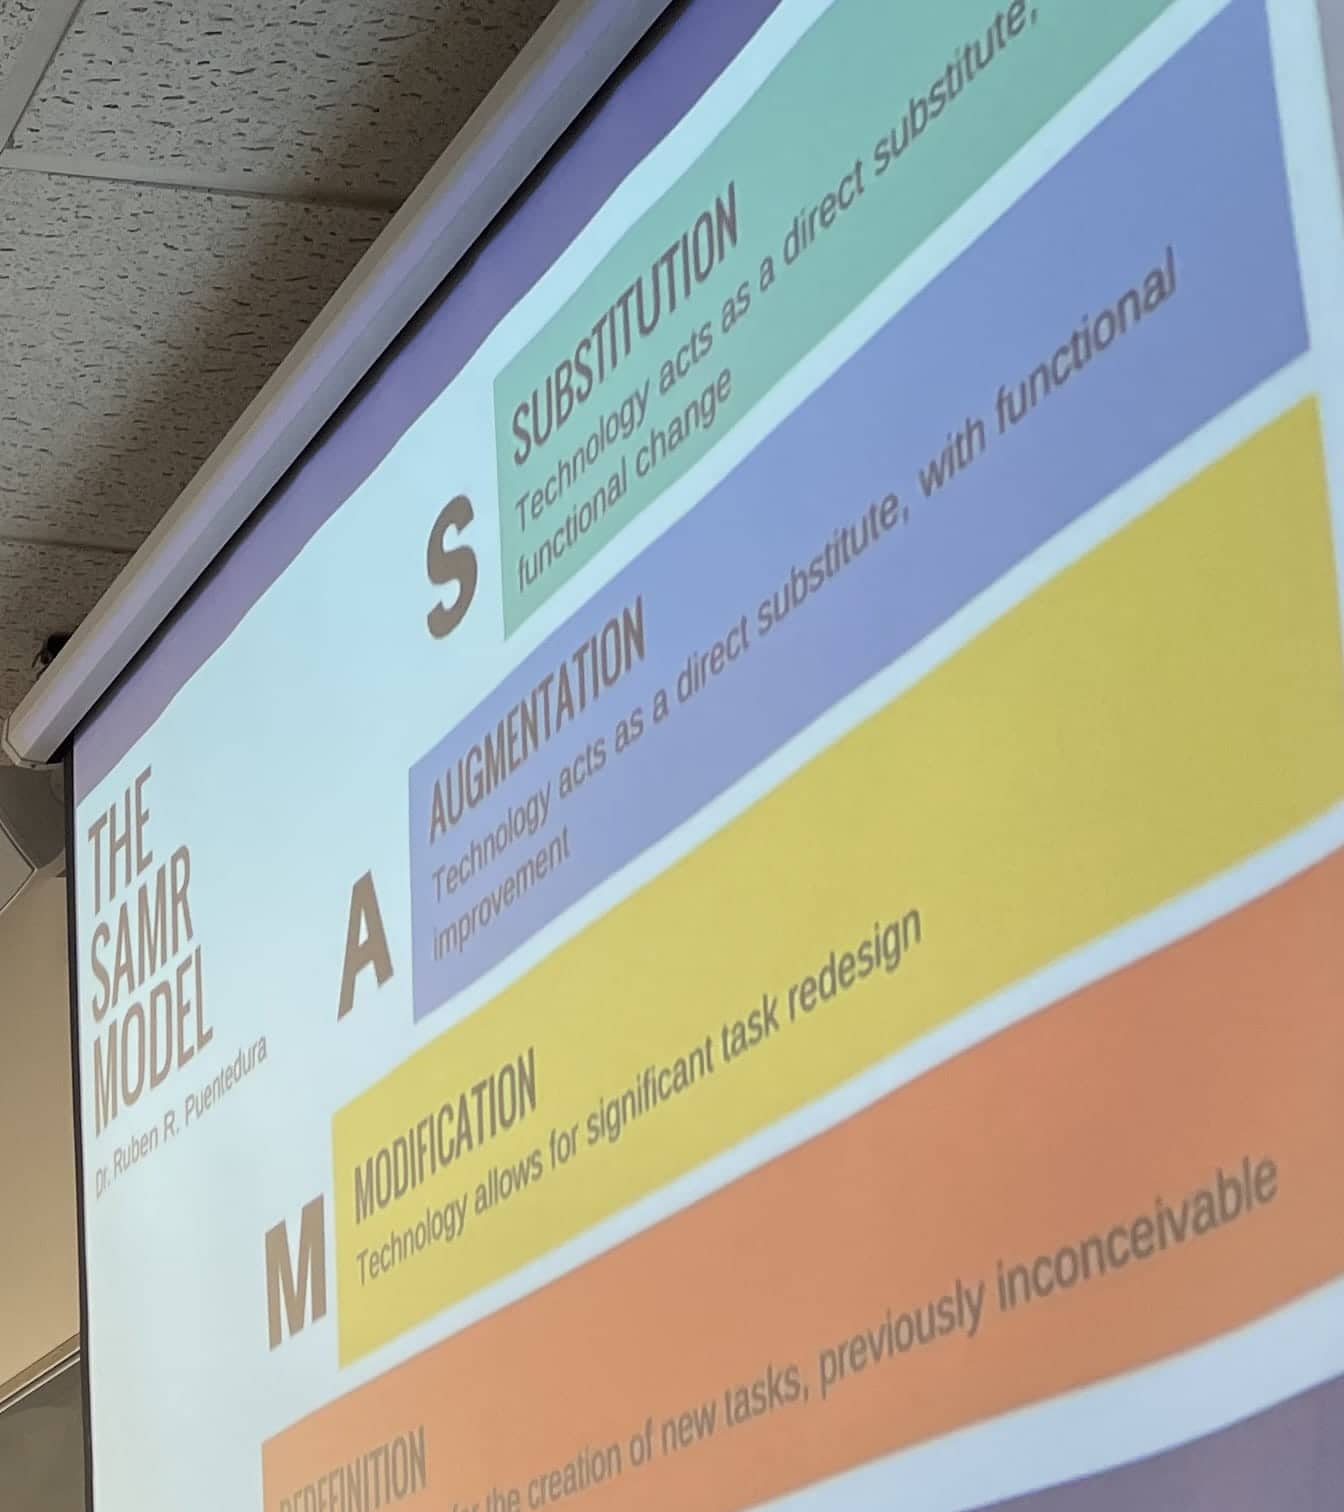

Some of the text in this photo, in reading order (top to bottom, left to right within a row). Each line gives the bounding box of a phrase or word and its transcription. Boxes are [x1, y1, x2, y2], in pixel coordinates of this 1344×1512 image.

[513, 180, 738, 466] SUBSTITUTION
[516, 0, 1038, 533] Technology acts as a direct substitute,
[427, 494, 478, 640] S
[518, 367, 732, 593] functional change
[431, 245, 1177, 905] Technology acts as a direct substitute, with functional
[429, 592, 646, 846] AUGMENTATION
[87, 764, 153, 916] THE
[90, 844, 194, 1025] SAMR
[433, 825, 572, 963] improvement
[337, 868, 394, 1023] A
[93, 942, 214, 1140] MODEL
[95, 1034, 268, 1202] Dr. Ruben R. Puentedura
[354, 1046, 537, 1225] MODIFICATION
[356, 907, 923, 1287] Technology allows for significant task redesign
[264, 1193, 327, 1352] M
[528, 1440, 624, 1512] creation
[629, 1417, 654, 1468] of
[661, 1402, 717, 1456] new
[725, 1362, 809, 1430] tasks,
[819, 1278, 986, 1401] previously
[997, 1154, 1279, 1313] inconceivable
